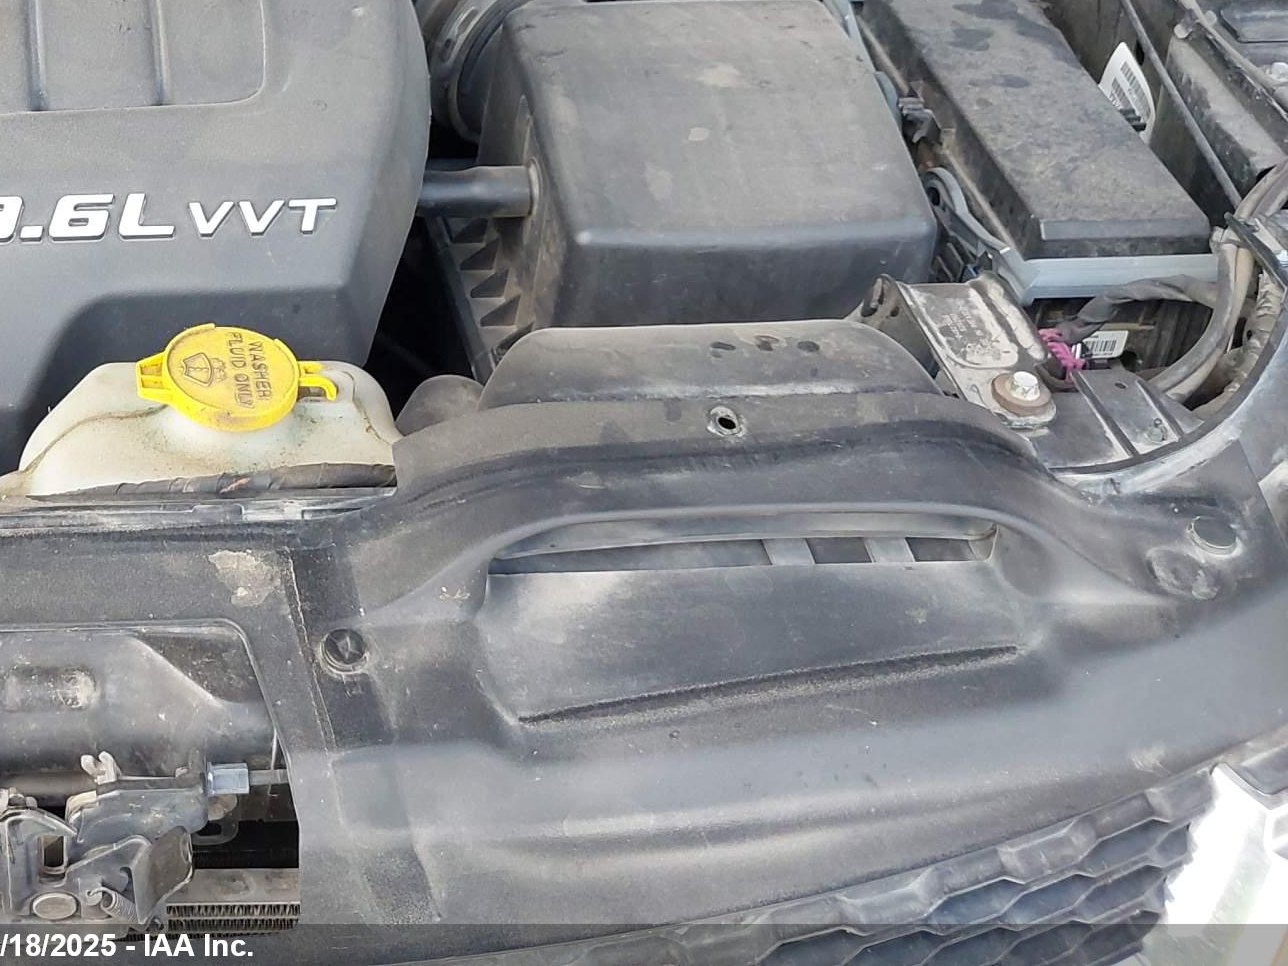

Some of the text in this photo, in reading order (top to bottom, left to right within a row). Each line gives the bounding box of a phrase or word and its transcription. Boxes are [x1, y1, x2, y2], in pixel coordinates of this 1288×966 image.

[188, 197, 339, 237] VVT
[226, 332, 255, 409] FLUID ONLY
[248, 341, 272, 401] WASHER
